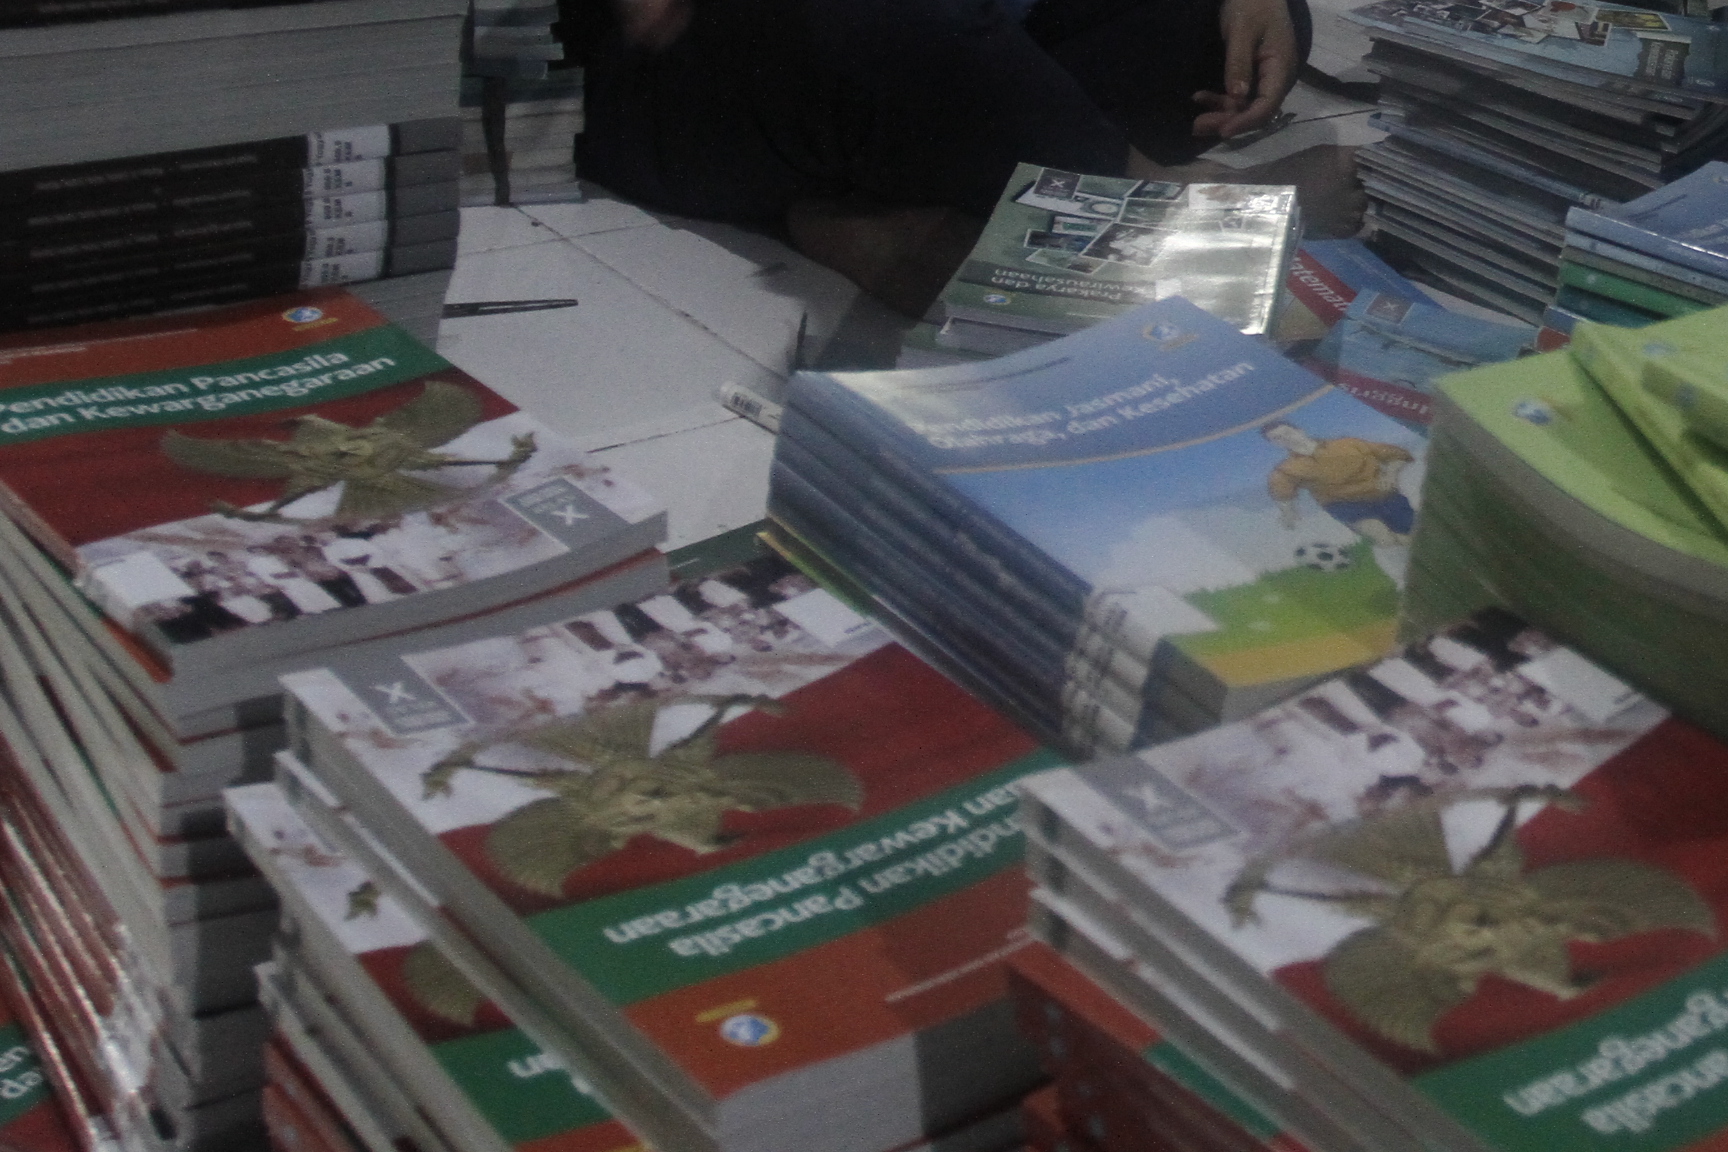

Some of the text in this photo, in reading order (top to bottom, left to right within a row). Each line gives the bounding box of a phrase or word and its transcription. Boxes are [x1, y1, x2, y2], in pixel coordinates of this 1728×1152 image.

[991, 276, 1122, 300] Prakarya dan
[0, 351, 349, 415] endidikan Pancasila
[1, 356, 397, 435] dan Kewarganegaraan
[1066, 414, 1119, 436] dan
[1115, 361, 1255, 422] Kesehatan
[603, 810, 968, 944] Kewarganegaraan
[668, 815, 1023, 957] ndidikan Pancasila
